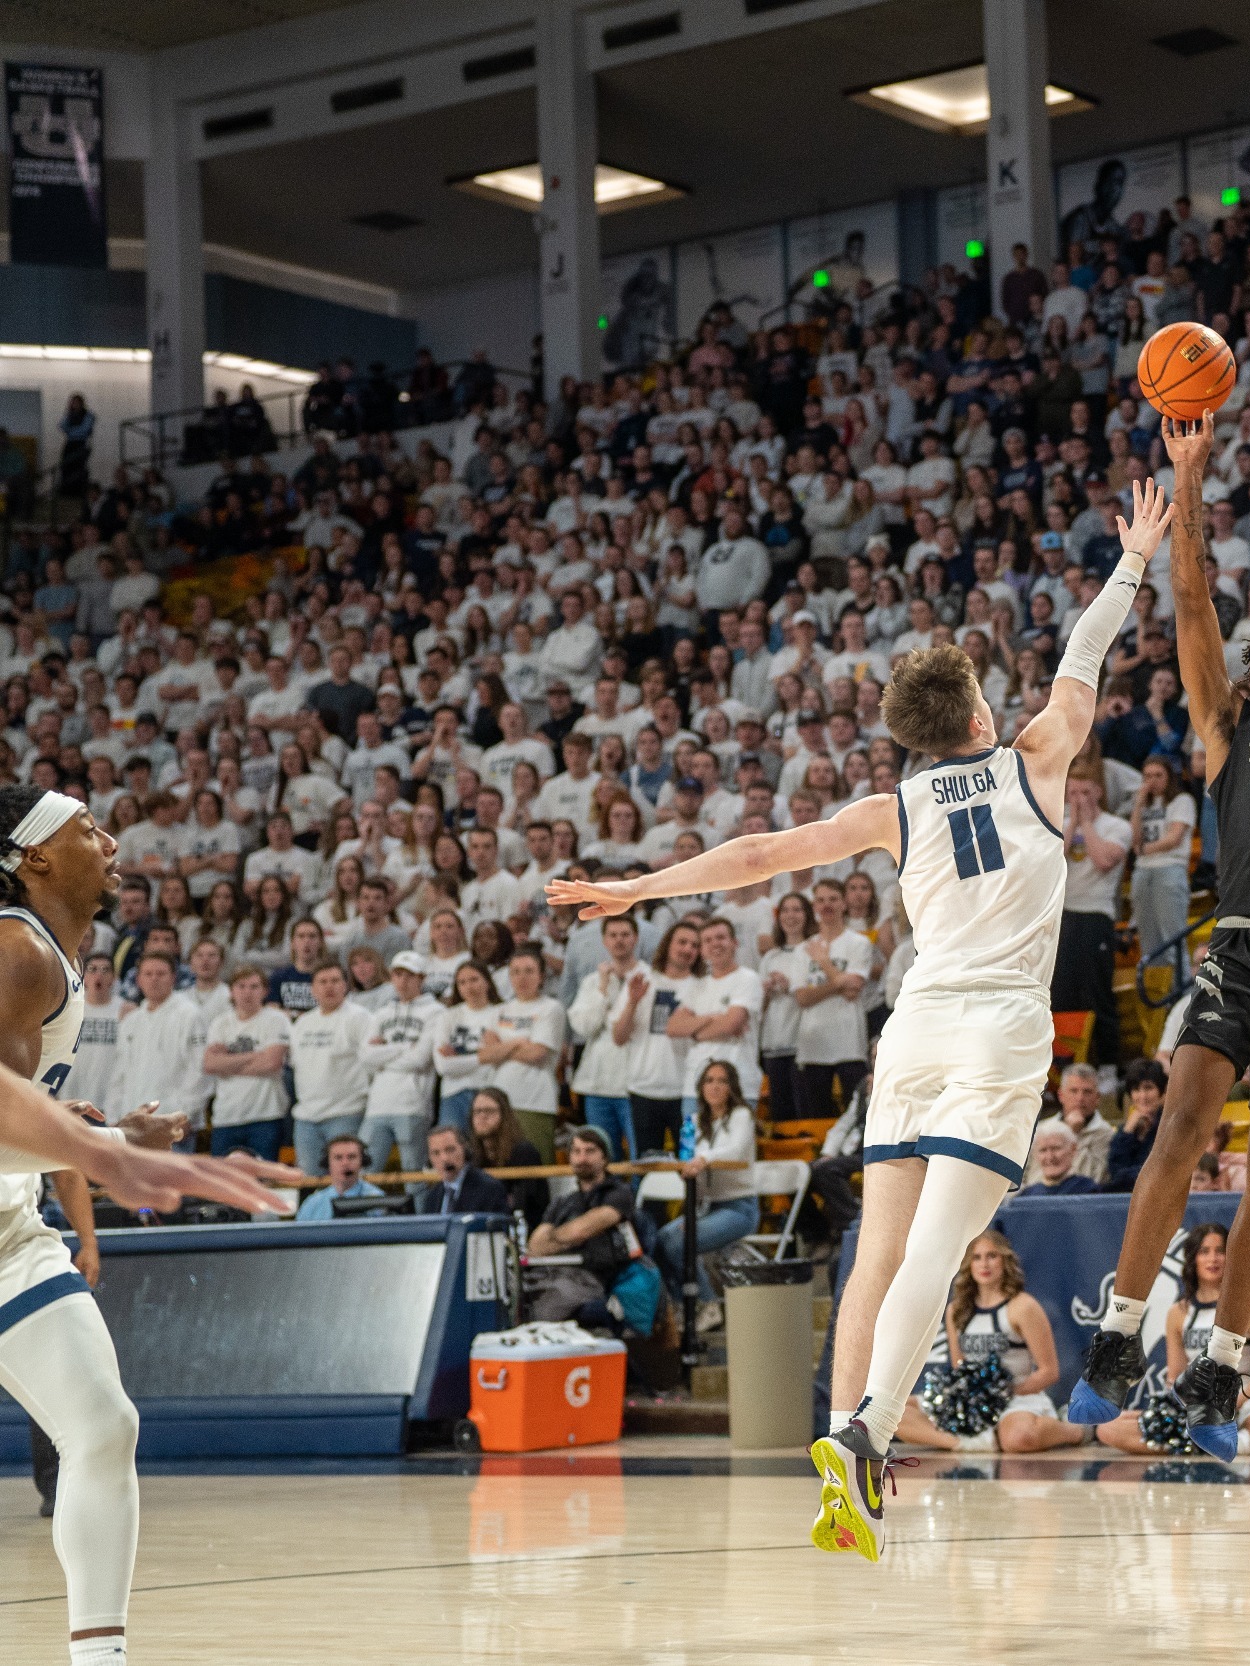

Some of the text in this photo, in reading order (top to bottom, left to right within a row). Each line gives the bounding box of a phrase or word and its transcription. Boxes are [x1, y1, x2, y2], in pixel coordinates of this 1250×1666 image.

[999, 159, 1018, 187] K
[931, 766, 998, 805] SHULGA
[947, 803, 1006, 880] 11
[565, 1366, 592, 1409] G
